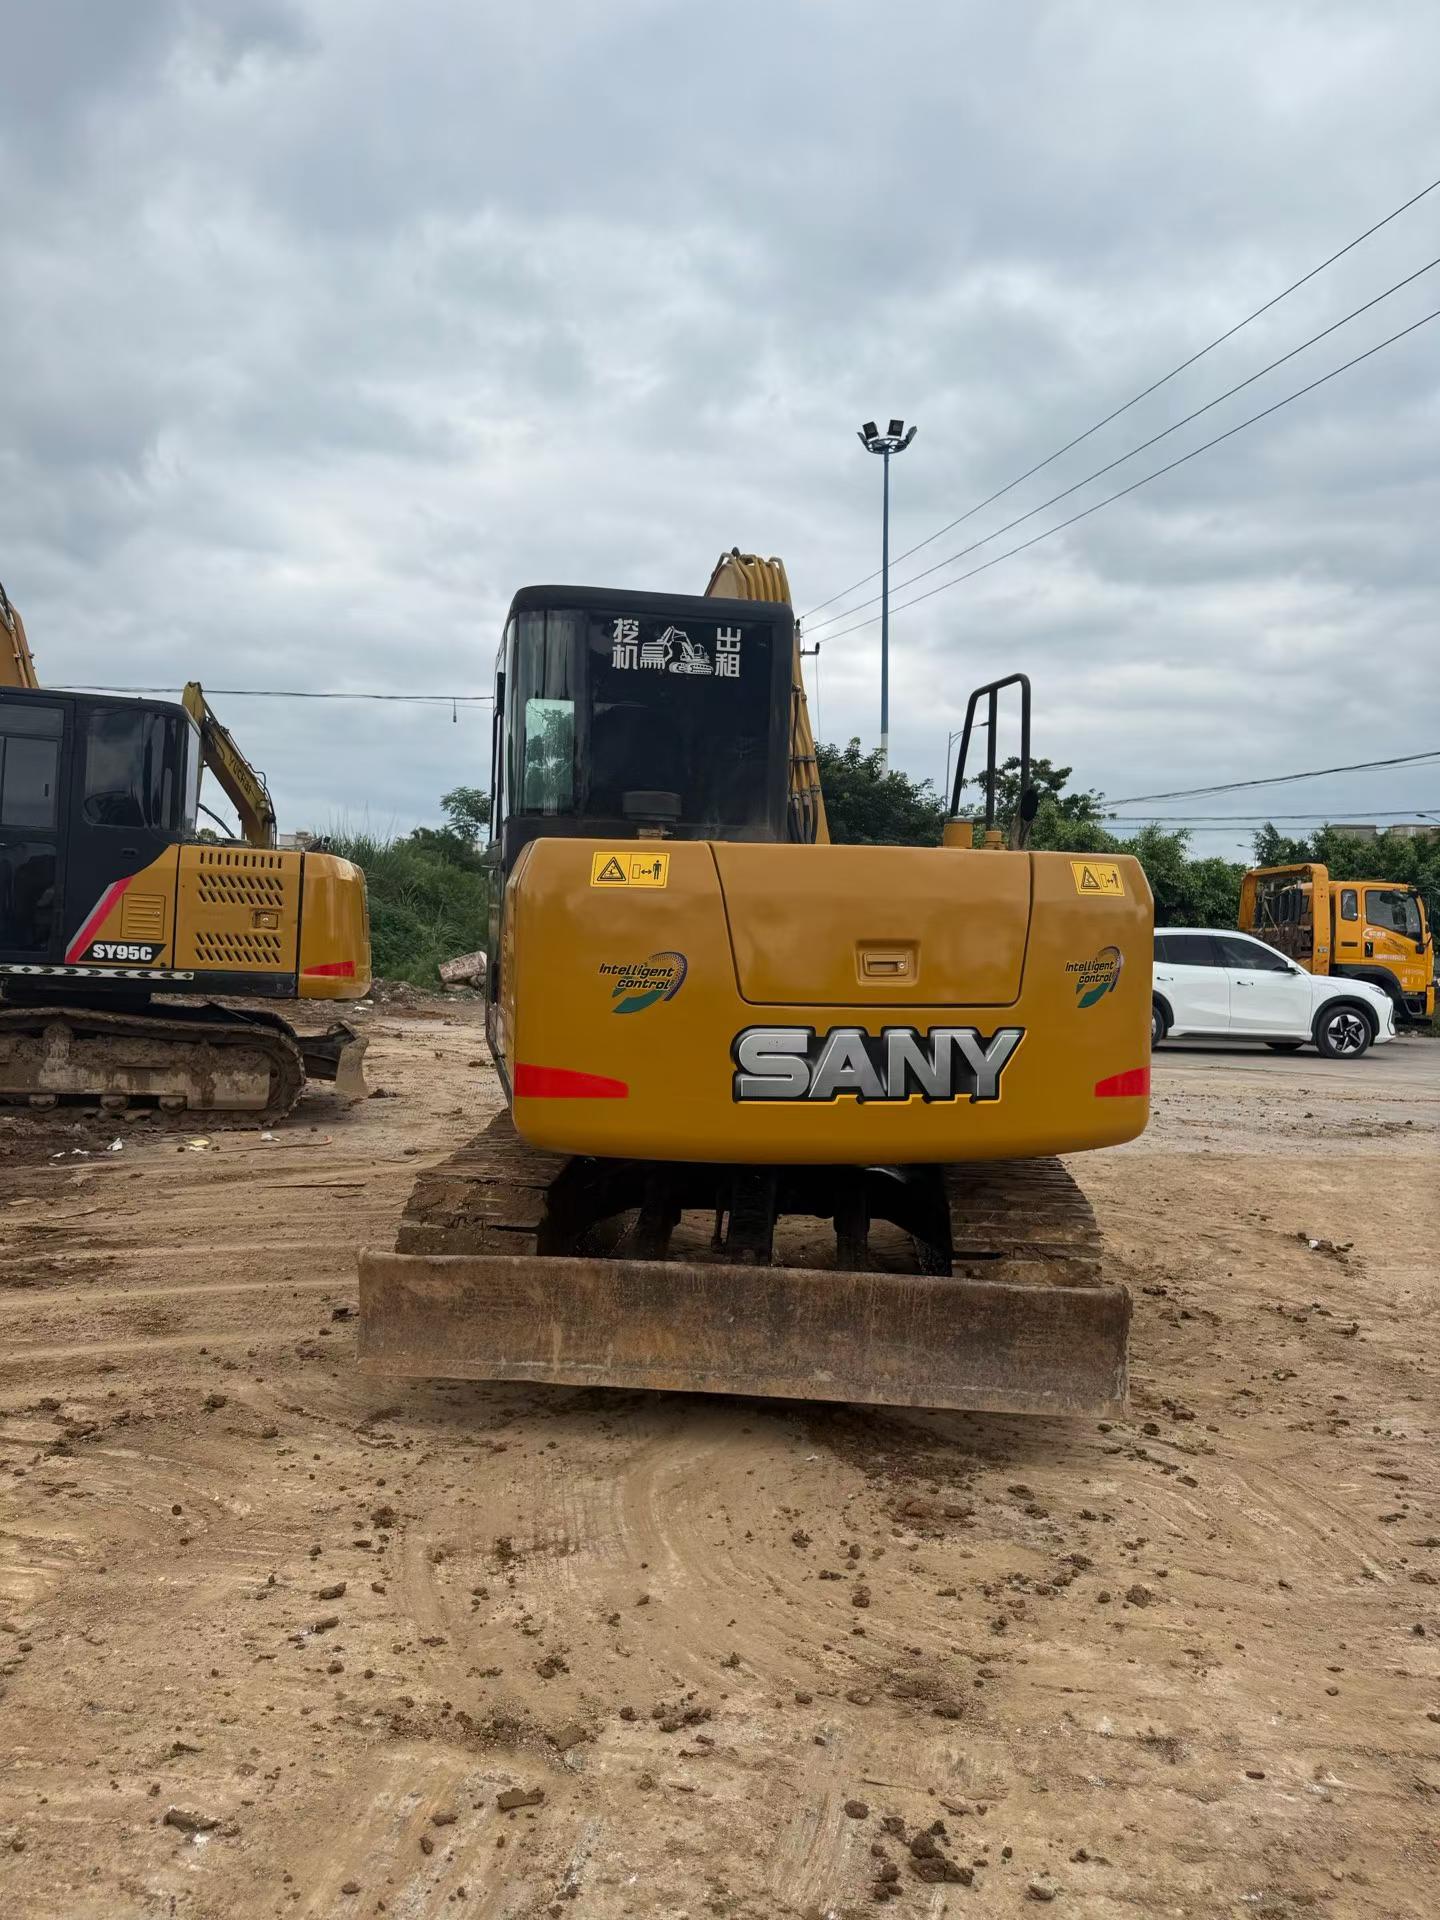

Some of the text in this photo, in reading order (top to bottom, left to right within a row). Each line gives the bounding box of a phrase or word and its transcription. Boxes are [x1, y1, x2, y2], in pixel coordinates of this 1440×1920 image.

[612, 618, 638, 669] 挖机
[715, 627, 742, 678] 出租
[92, 943, 152, 960] SY95C
[599, 963, 675, 979] Intelligent
[1065, 960, 1114, 973] Intelligent
[617, 978, 671, 990] control
[1079, 972, 1113, 984] control
[733, 1027, 1023, 1100] SANY
